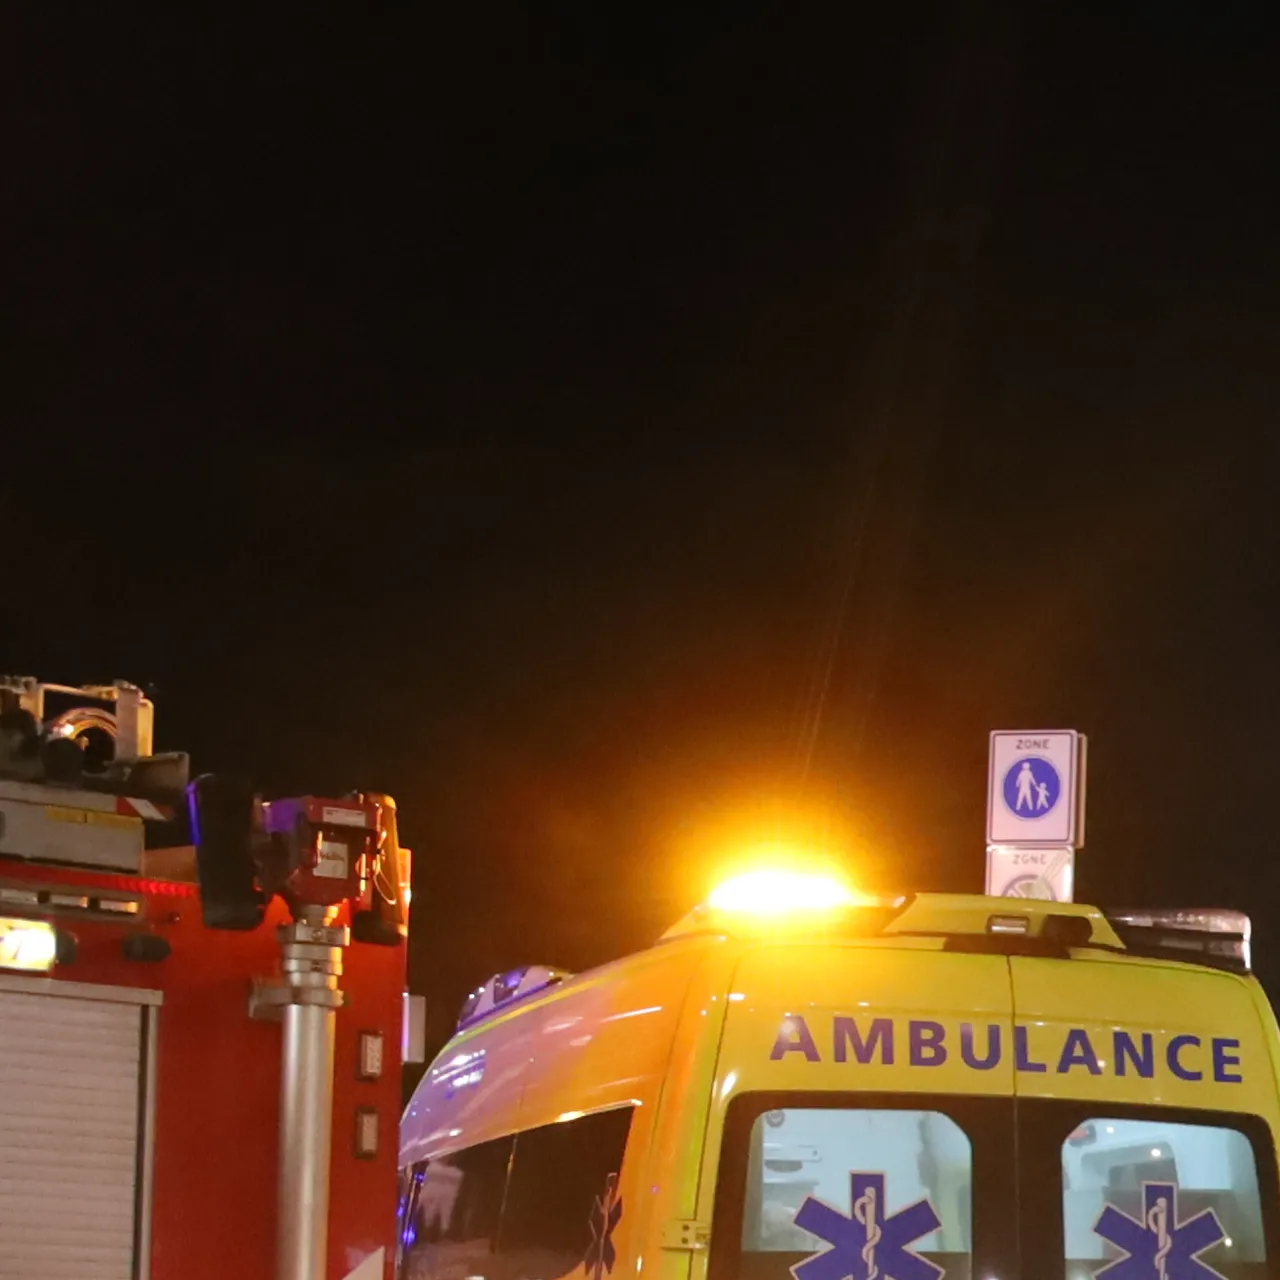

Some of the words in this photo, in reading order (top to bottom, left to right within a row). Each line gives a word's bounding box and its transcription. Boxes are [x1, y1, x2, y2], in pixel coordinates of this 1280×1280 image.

[1015, 739, 1051, 750] ZONE
[1011, 853, 1047, 865] ZONE
[770, 1014, 1244, 1084] AMBULANCE
